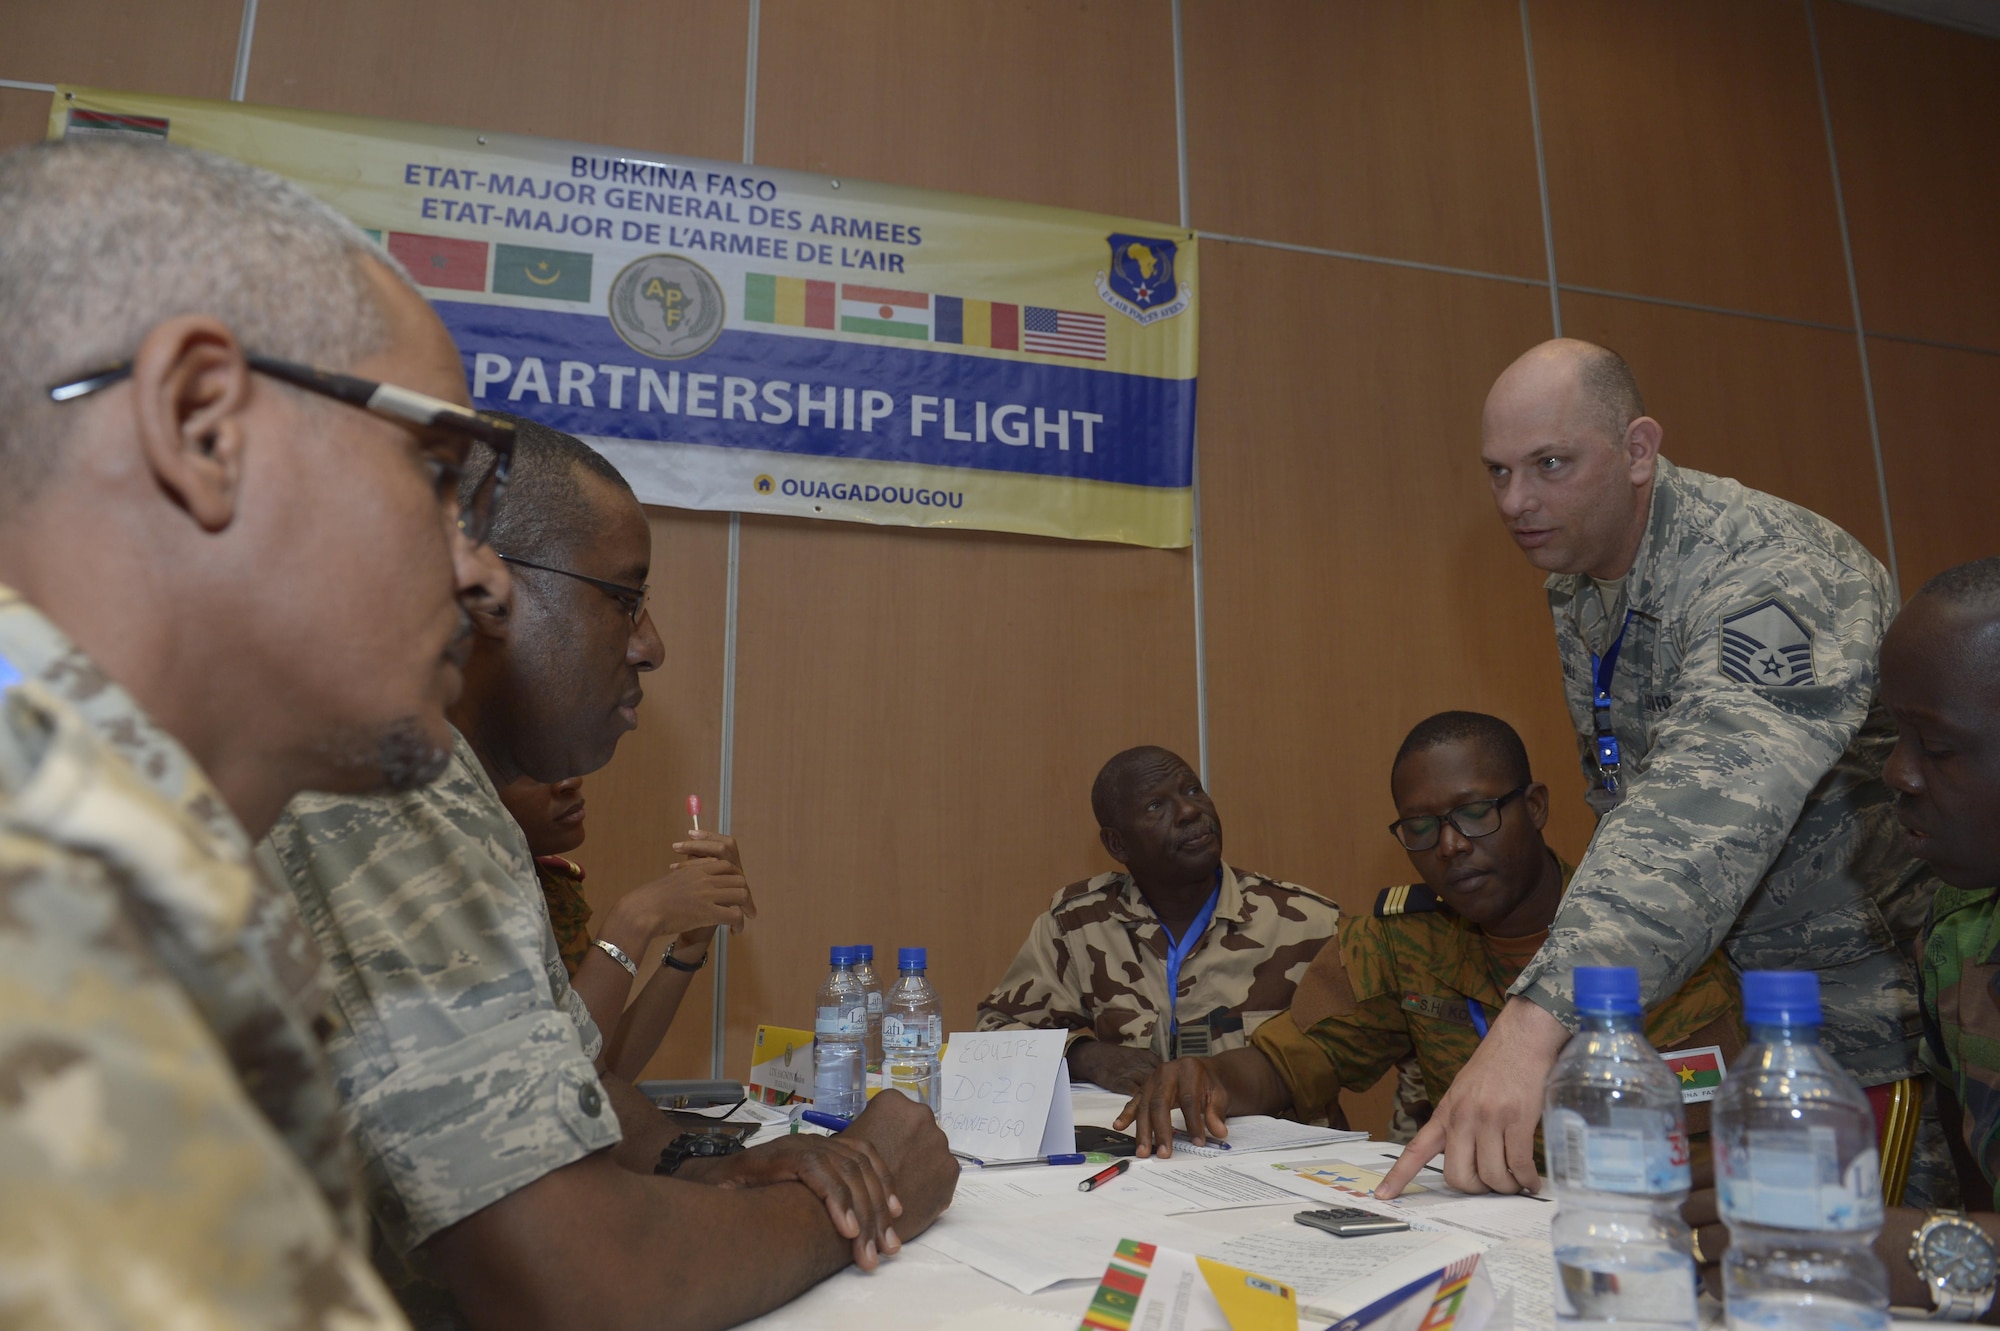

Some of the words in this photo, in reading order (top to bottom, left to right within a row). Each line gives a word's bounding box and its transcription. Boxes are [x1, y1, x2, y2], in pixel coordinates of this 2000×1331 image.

[404, 163, 595, 206] ETAT-MAJOR
[604, 188, 740, 223] GENERAL
[748, 205, 802, 231] DES
[809, 214, 922, 246] ARMEES
[571, 156, 697, 192] BURKINA
[706, 173, 776, 201] FASO
[421, 197, 613, 239] ETAT-MAJOR
[622, 221, 660, 245] DE
[669, 226, 788, 260] L'ARMEE
[796, 242, 833, 266] DE
[841, 247, 905, 274] L'AIR
[473, 353, 894, 432] PARTNERSHIP
[911, 395, 1103, 454] FLIGHT
[781, 478, 963, 509] OUAGADOUGOU
[959, 1040, 1038, 1063] EQUIPE
